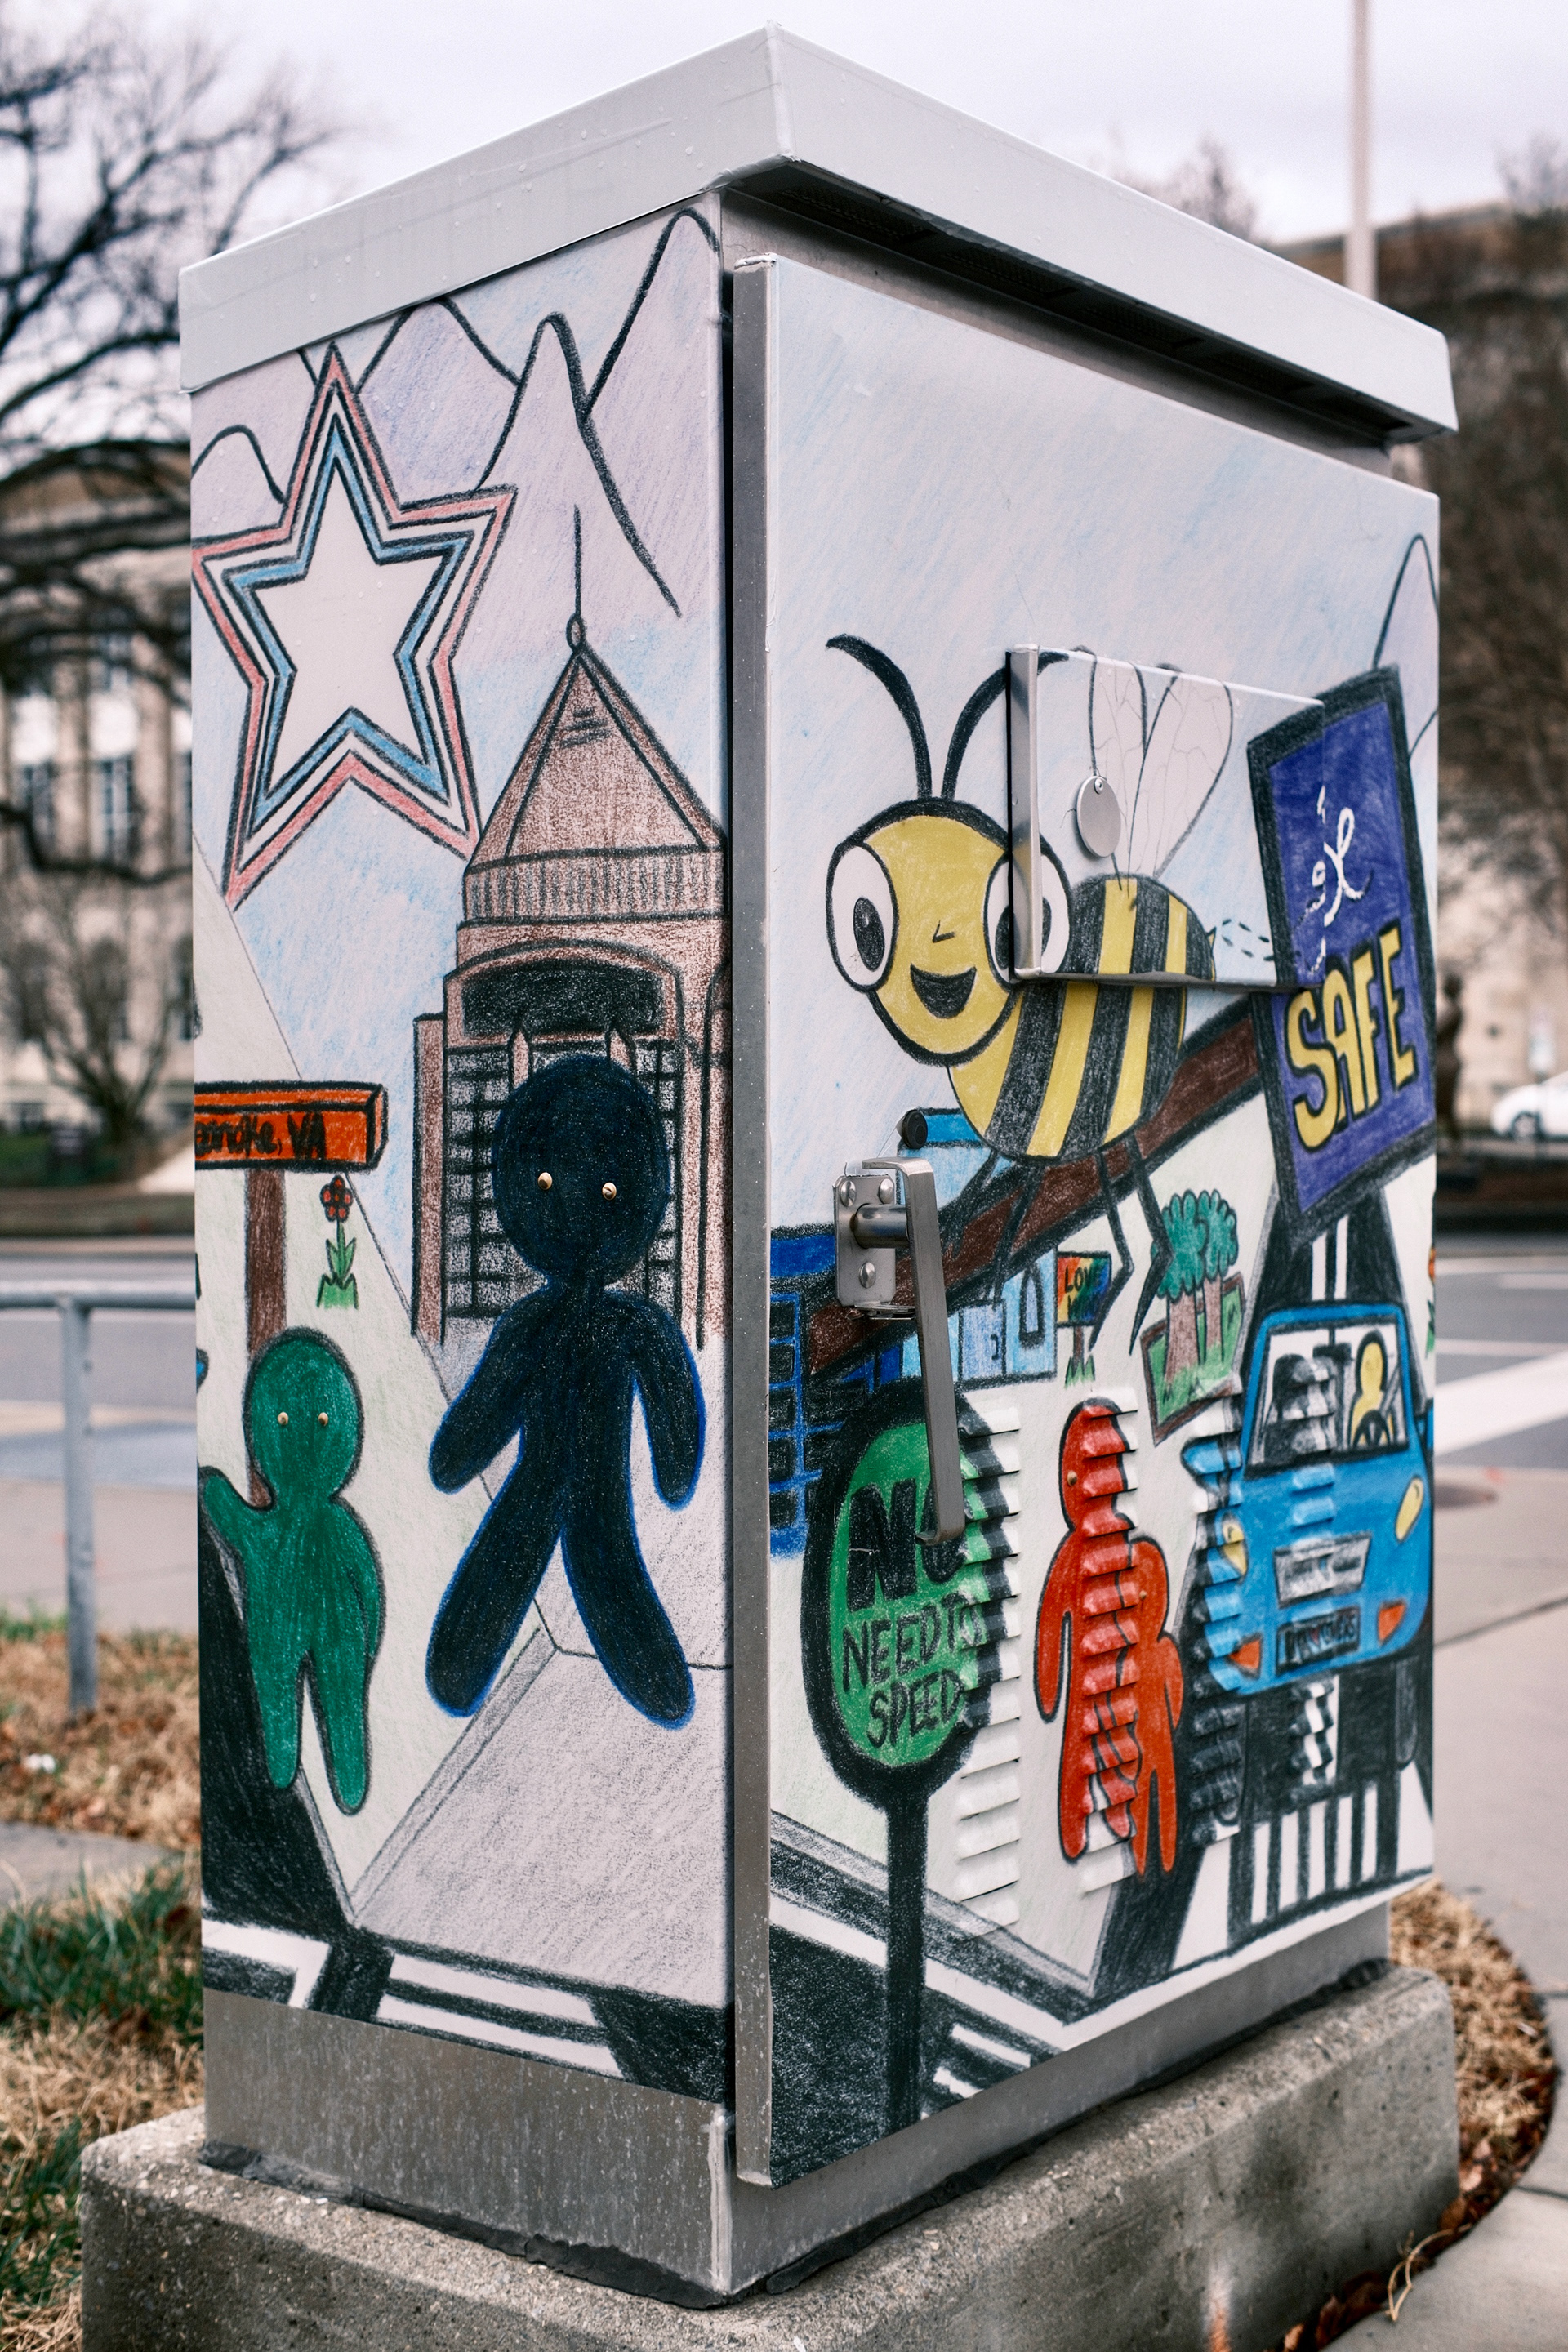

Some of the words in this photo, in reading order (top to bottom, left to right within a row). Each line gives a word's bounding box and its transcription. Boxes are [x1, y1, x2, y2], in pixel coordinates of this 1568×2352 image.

[1285, 920, 1418, 1149] SAFE
[287, 1111, 327, 1160] VA
[843, 1603, 942, 1693] NEED
[867, 1668, 965, 1748] SPEED
